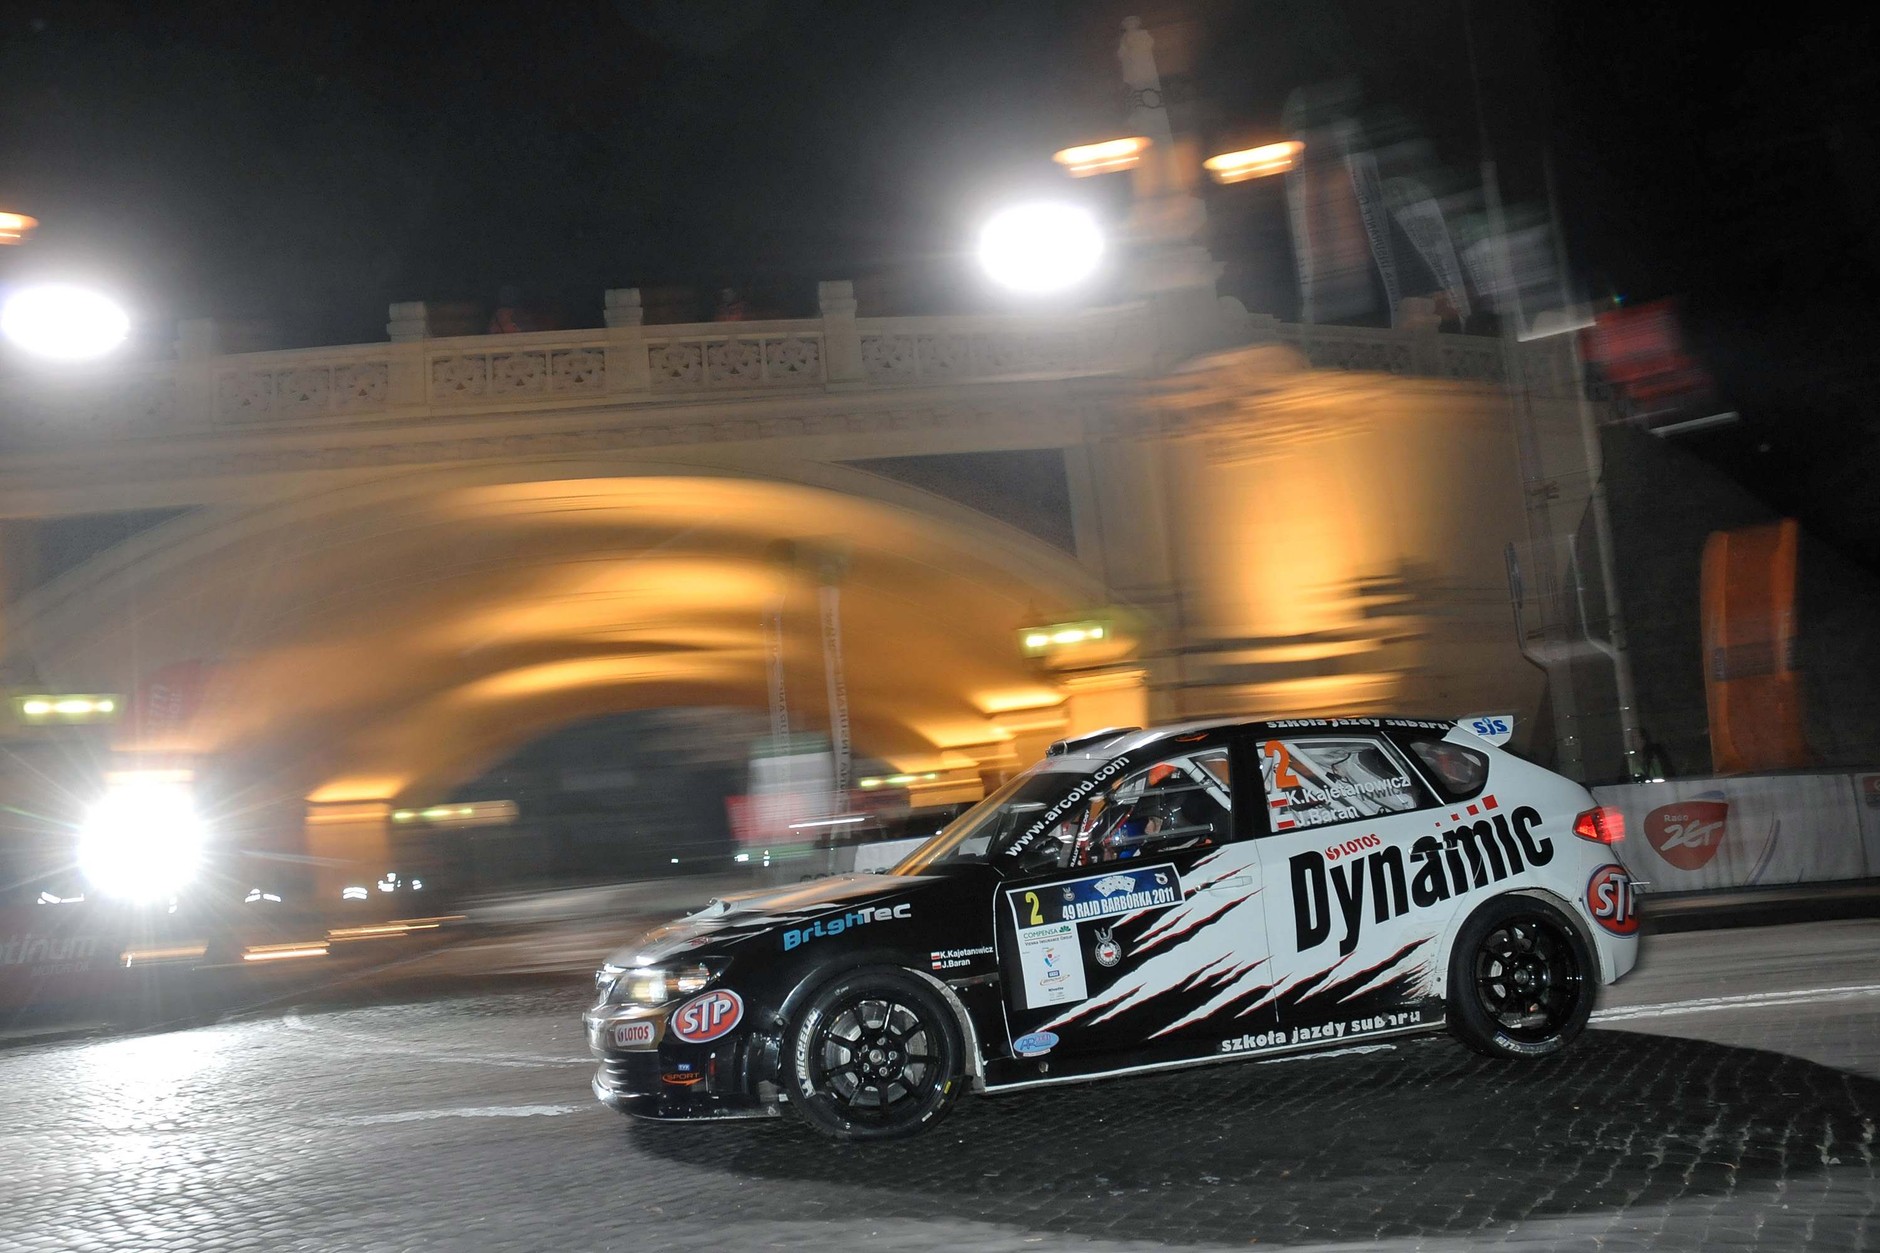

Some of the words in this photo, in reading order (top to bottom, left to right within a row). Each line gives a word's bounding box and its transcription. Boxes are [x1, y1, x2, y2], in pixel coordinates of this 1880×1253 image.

[1472, 716, 1508, 735] sjs
[1264, 739, 1300, 789] 2
[1286, 776, 1412, 806] K.Kajetanowicz
[1005, 756, 1130, 857] www.arcold.com
[1294, 805, 1360, 827] J.Baran
[1340, 833, 1381, 856] LOTOS
[1289, 806, 1555, 957] Dynamic
[1025, 891, 1044, 926] 2
[1062, 904, 1076, 921] 49
[1077, 901, 1101, 919] RAJD
[1101, 891, 1153, 914] BARBÓRKA
[1152, 886, 1175, 905] 2011
[1023, 928, 1059, 939] COMPENSA
[942, 959, 971, 969] J.Baran
[683, 994, 732, 1034] STP
[624, 1025, 649, 1041] LOTOS
[1221, 1030, 1287, 1052] szkoła
[1291, 1021, 1346, 1044] jazdy
